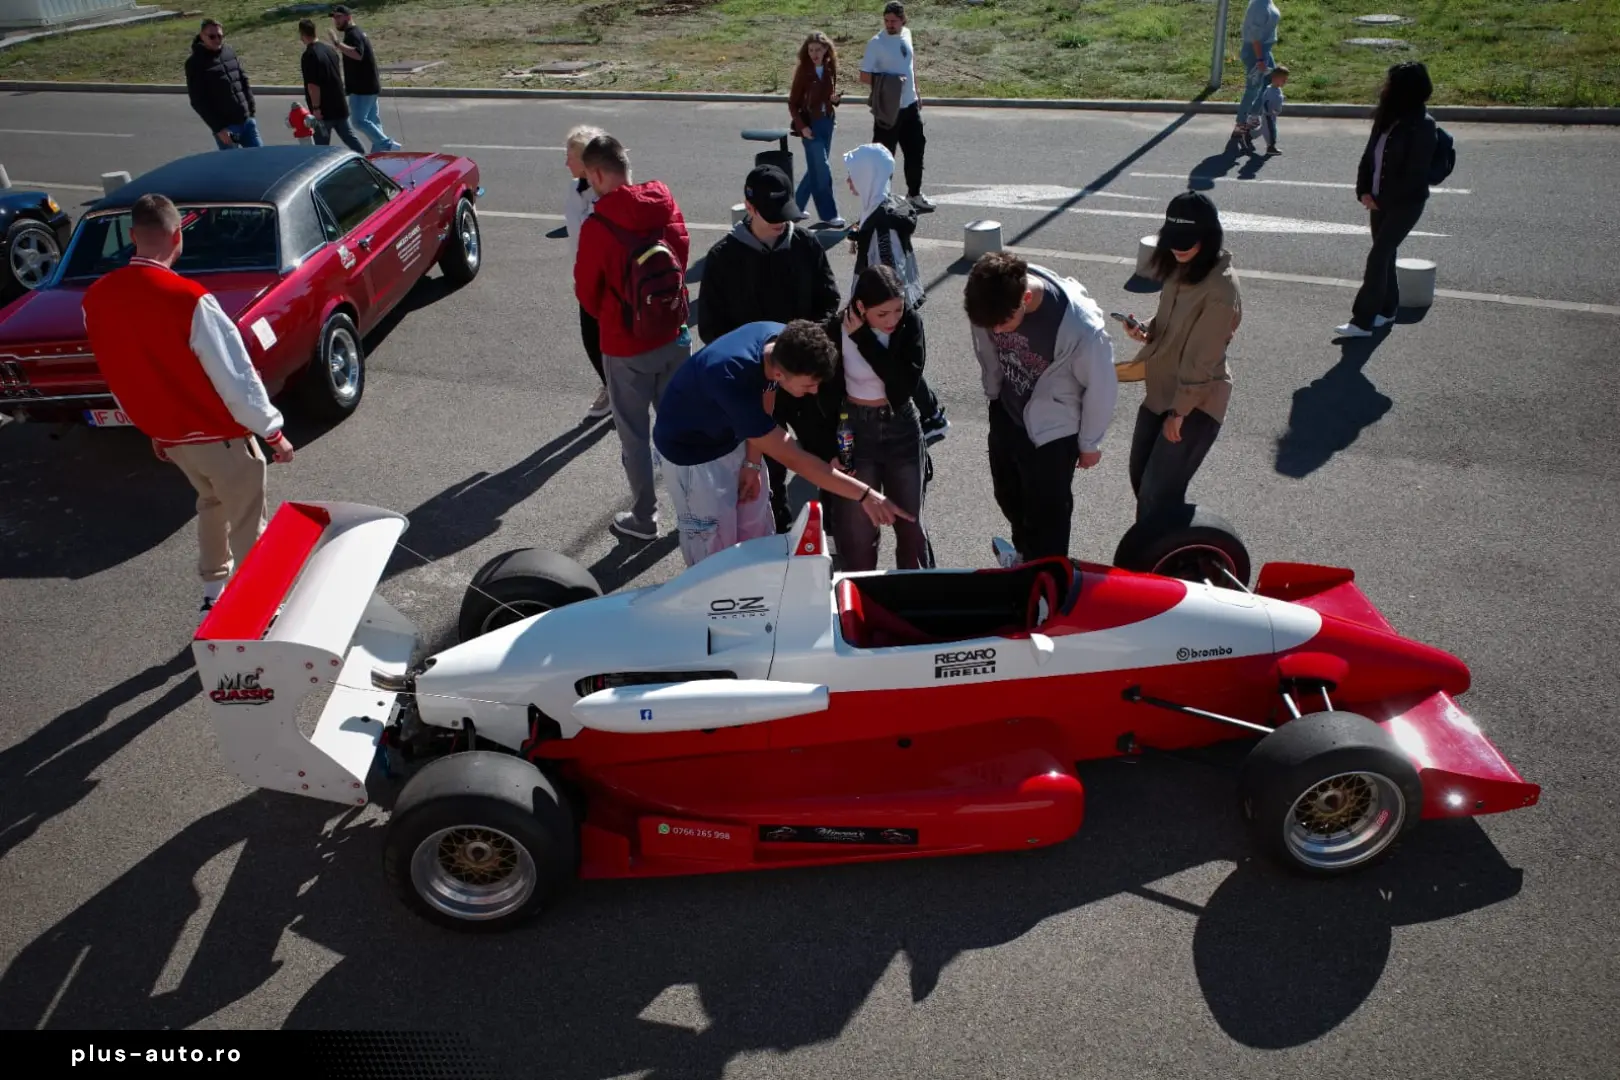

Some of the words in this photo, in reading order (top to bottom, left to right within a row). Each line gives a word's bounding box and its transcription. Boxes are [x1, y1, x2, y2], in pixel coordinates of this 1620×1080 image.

[94, 411, 109, 425] IF
[935, 648, 996, 665] RECARO
[1191, 646, 1232, 658] brembo
[935, 661, 996, 679] PIRELLI
[218, 673, 260, 689] MC
[209, 687, 275, 701] CLASSIC
[672, 827, 696, 837] 0766
[696, 828, 713, 839] 265
